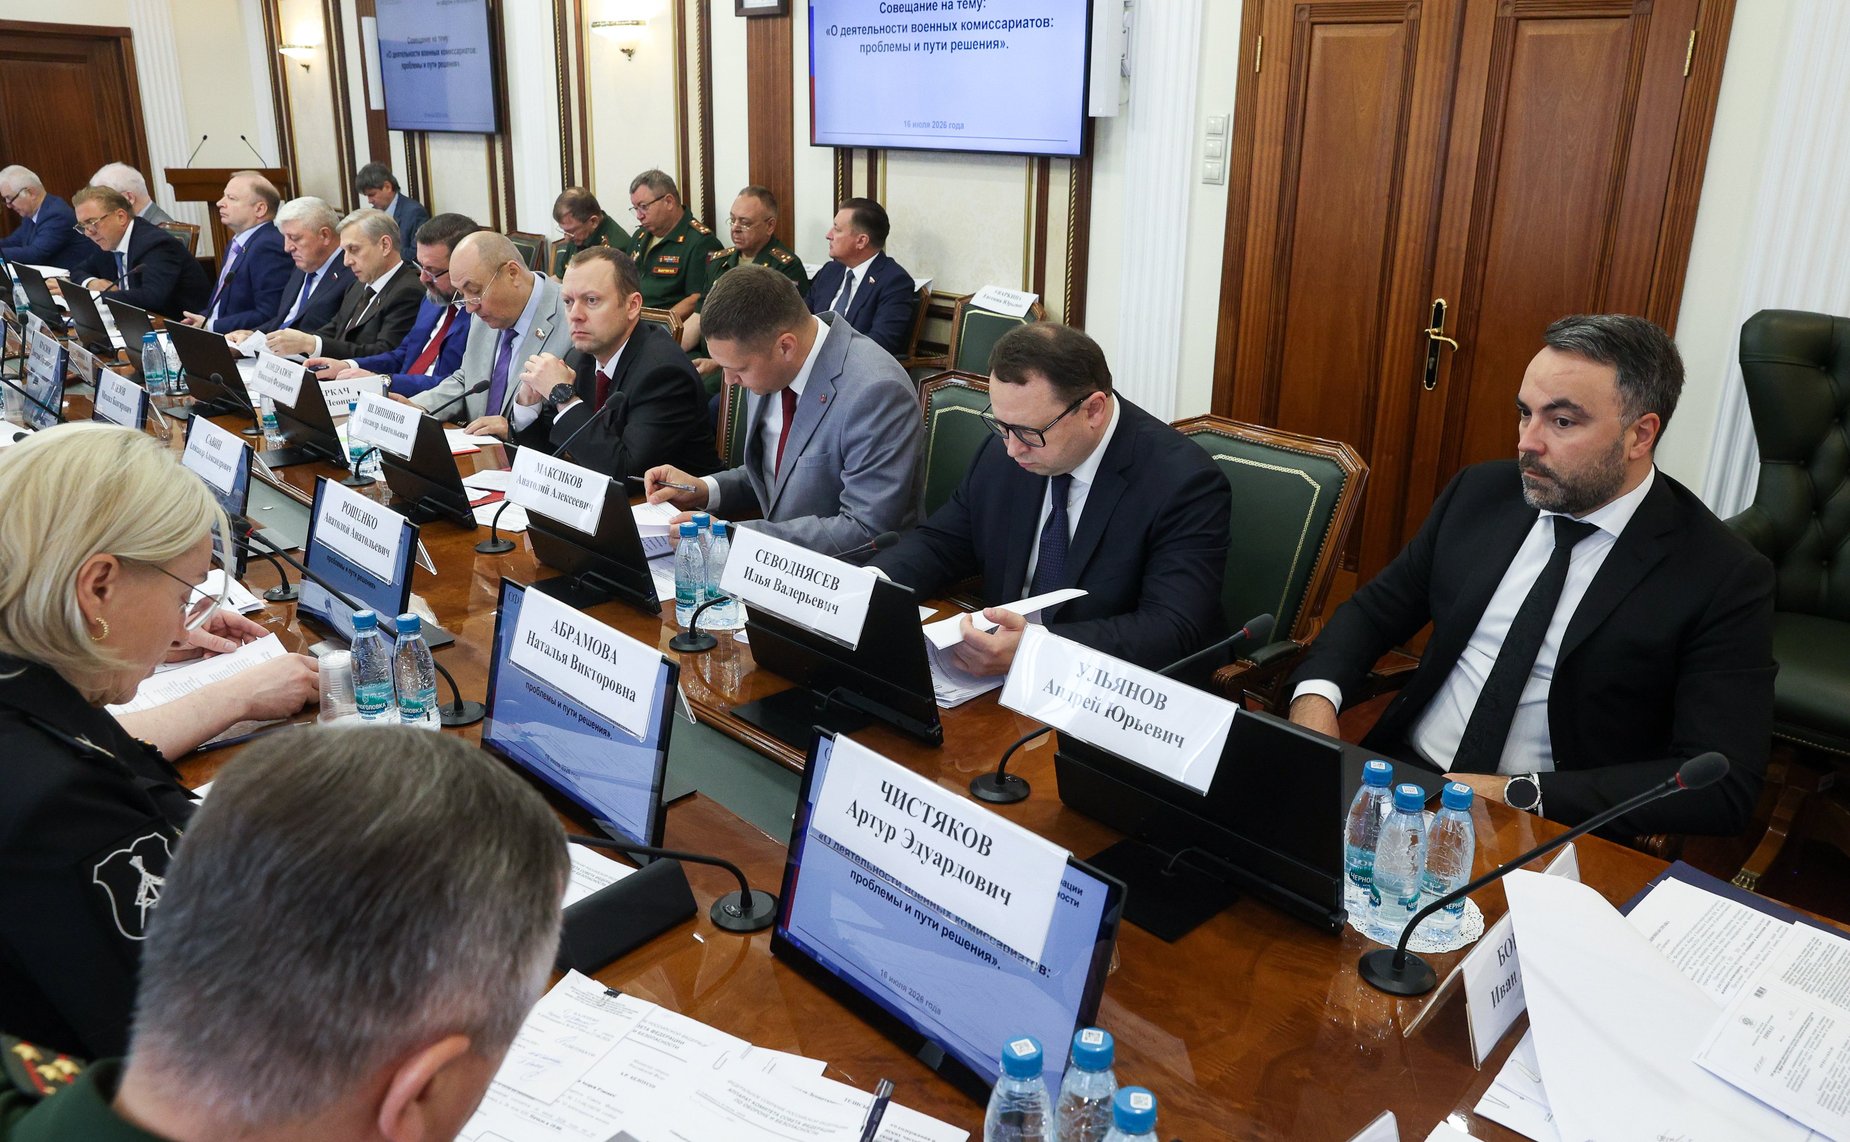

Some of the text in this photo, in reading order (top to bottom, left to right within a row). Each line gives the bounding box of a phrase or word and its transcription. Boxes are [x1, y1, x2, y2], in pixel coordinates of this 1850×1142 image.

[825, 16, 1054, 38] «О деятельности военных комиссариатов:
[879, 0, 987, 14] Совещание на тему:
[859, 38, 1009, 55] проблемы и пути решения».
[904, 120, 911, 128] 16
[948, 122, 964, 130] года
[323, 387, 350, 397] РКАЧ
[516, 474, 594, 513] Анатолий Алексеевич
[534, 462, 583, 489] МАКСИКОВ
[324, 512, 390, 558] Анатолий Анатольевич
[743, 566, 840, 616] Илья Валерьевич
[755, 548, 840, 591] СЕВОДНЯСЕВ
[551, 618, 617, 666] АБРАМОВА
[526, 630, 637, 703] Наталья Викторовна
[1076, 661, 1168, 712] УЛЬЯНОВ
[526, 682, 613, 740] проблемы и пути решения».
[1042, 677, 1186, 750] Андрей Юрьевич
[881, 779, 993, 858] ЧИСТЯКОВ
[845, 799, 1013, 907] Артур Эдуардович
[850, 869, 1001, 970] проблемы и пути решения».
[880, 969, 888, 979] 16
[888, 976, 908, 992] июля
[925, 1000, 941, 1016] года
[1491, 971, 1518, 1009] Иван
